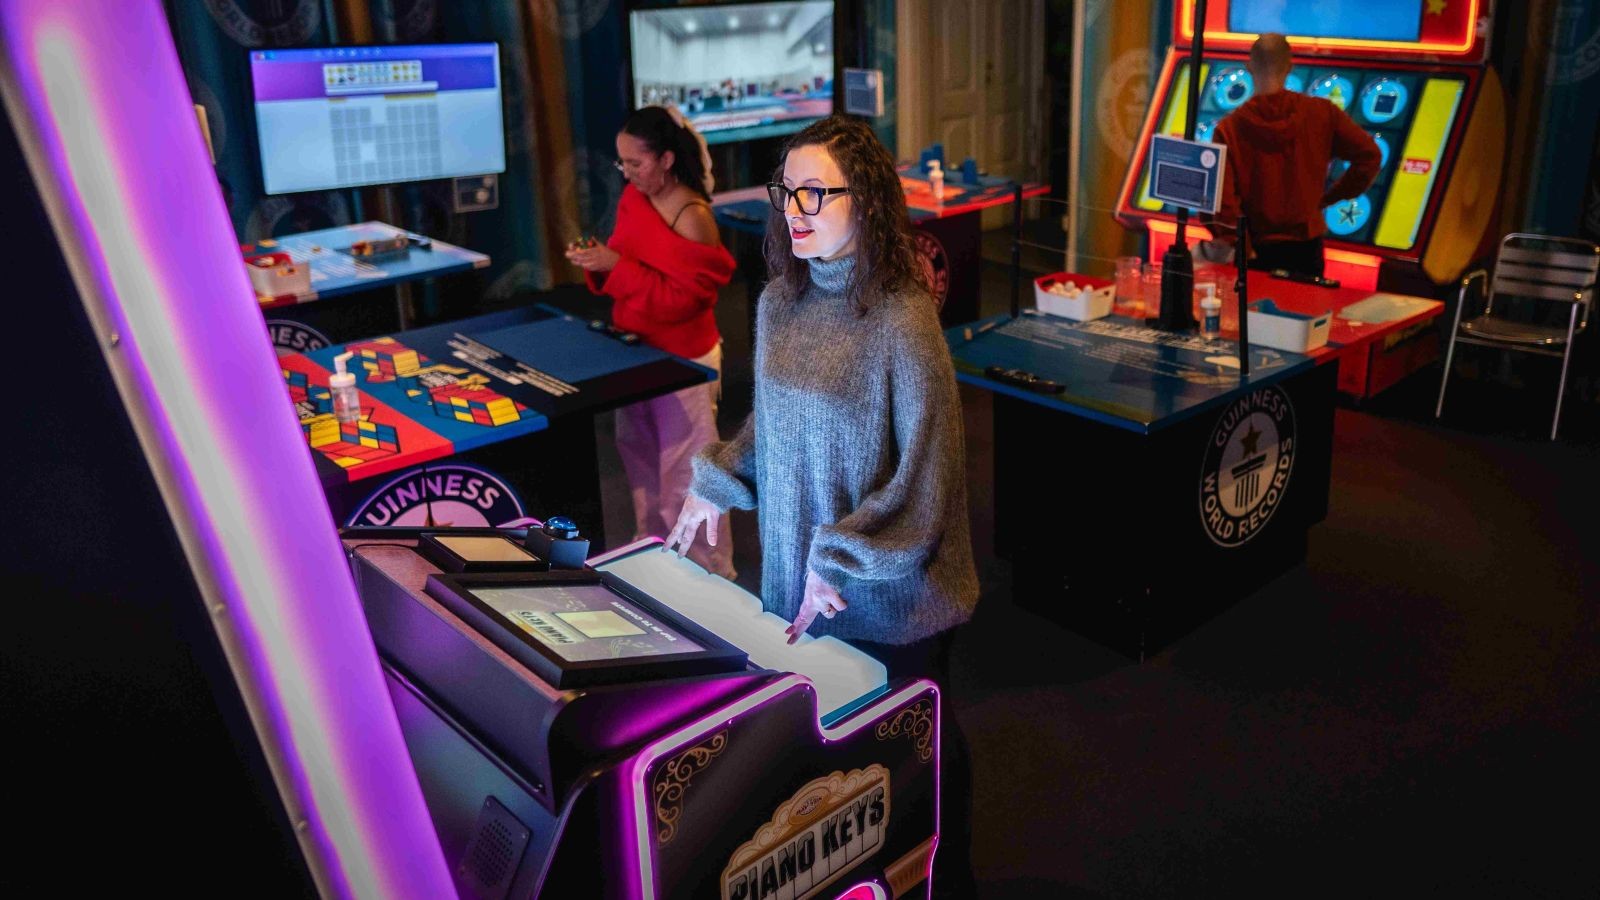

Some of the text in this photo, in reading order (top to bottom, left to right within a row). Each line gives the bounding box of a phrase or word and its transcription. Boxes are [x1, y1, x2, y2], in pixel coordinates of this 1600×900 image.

[1216, 389, 1288, 448] GUINNESS
[359, 474, 500, 526] UINNESS
[1203, 437, 1293, 540] WORLD RECORDS
[729, 786, 884, 900] PIANO KEYS
